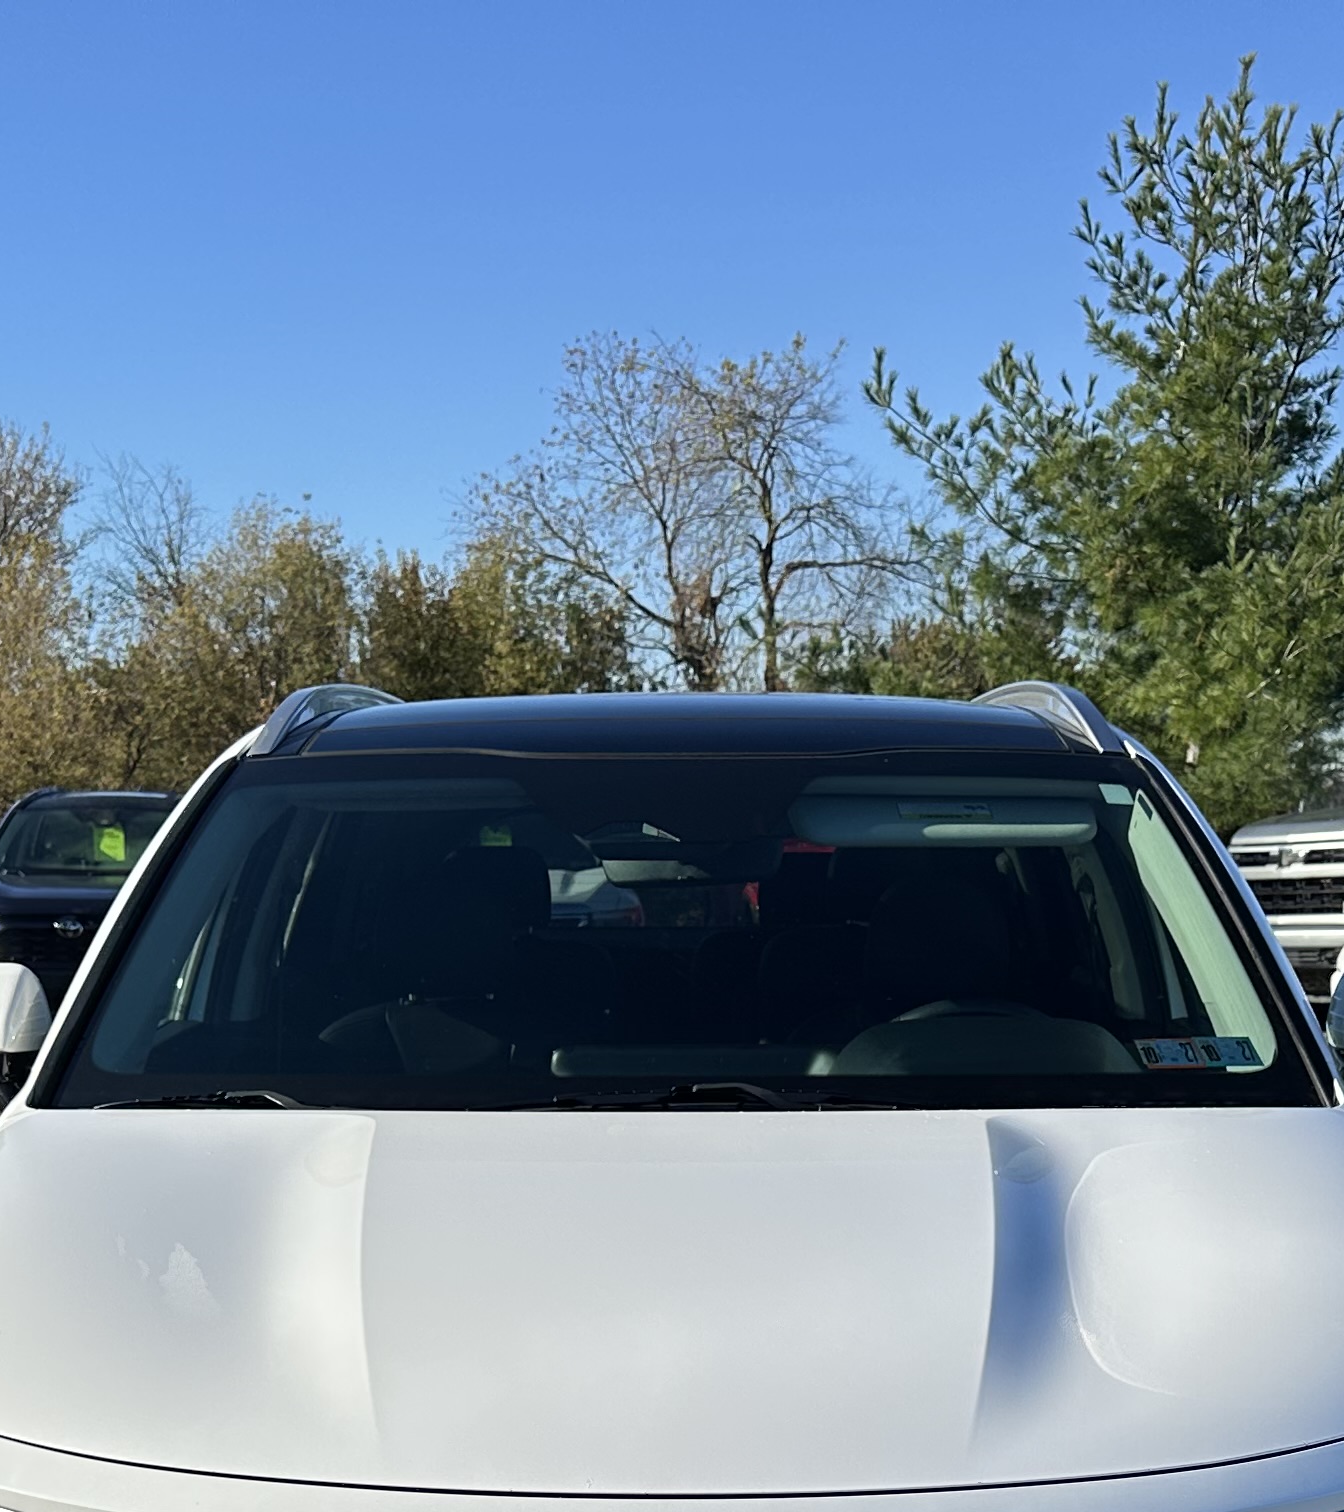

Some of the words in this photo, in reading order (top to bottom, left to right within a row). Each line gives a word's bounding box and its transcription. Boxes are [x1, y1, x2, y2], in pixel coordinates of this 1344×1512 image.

[1140, 1046, 1160, 1064] 10
[1179, 1042, 1199, 1064] 27
[1200, 1044, 1221, 1062] 10
[1236, 1040, 1256, 1062] 27
